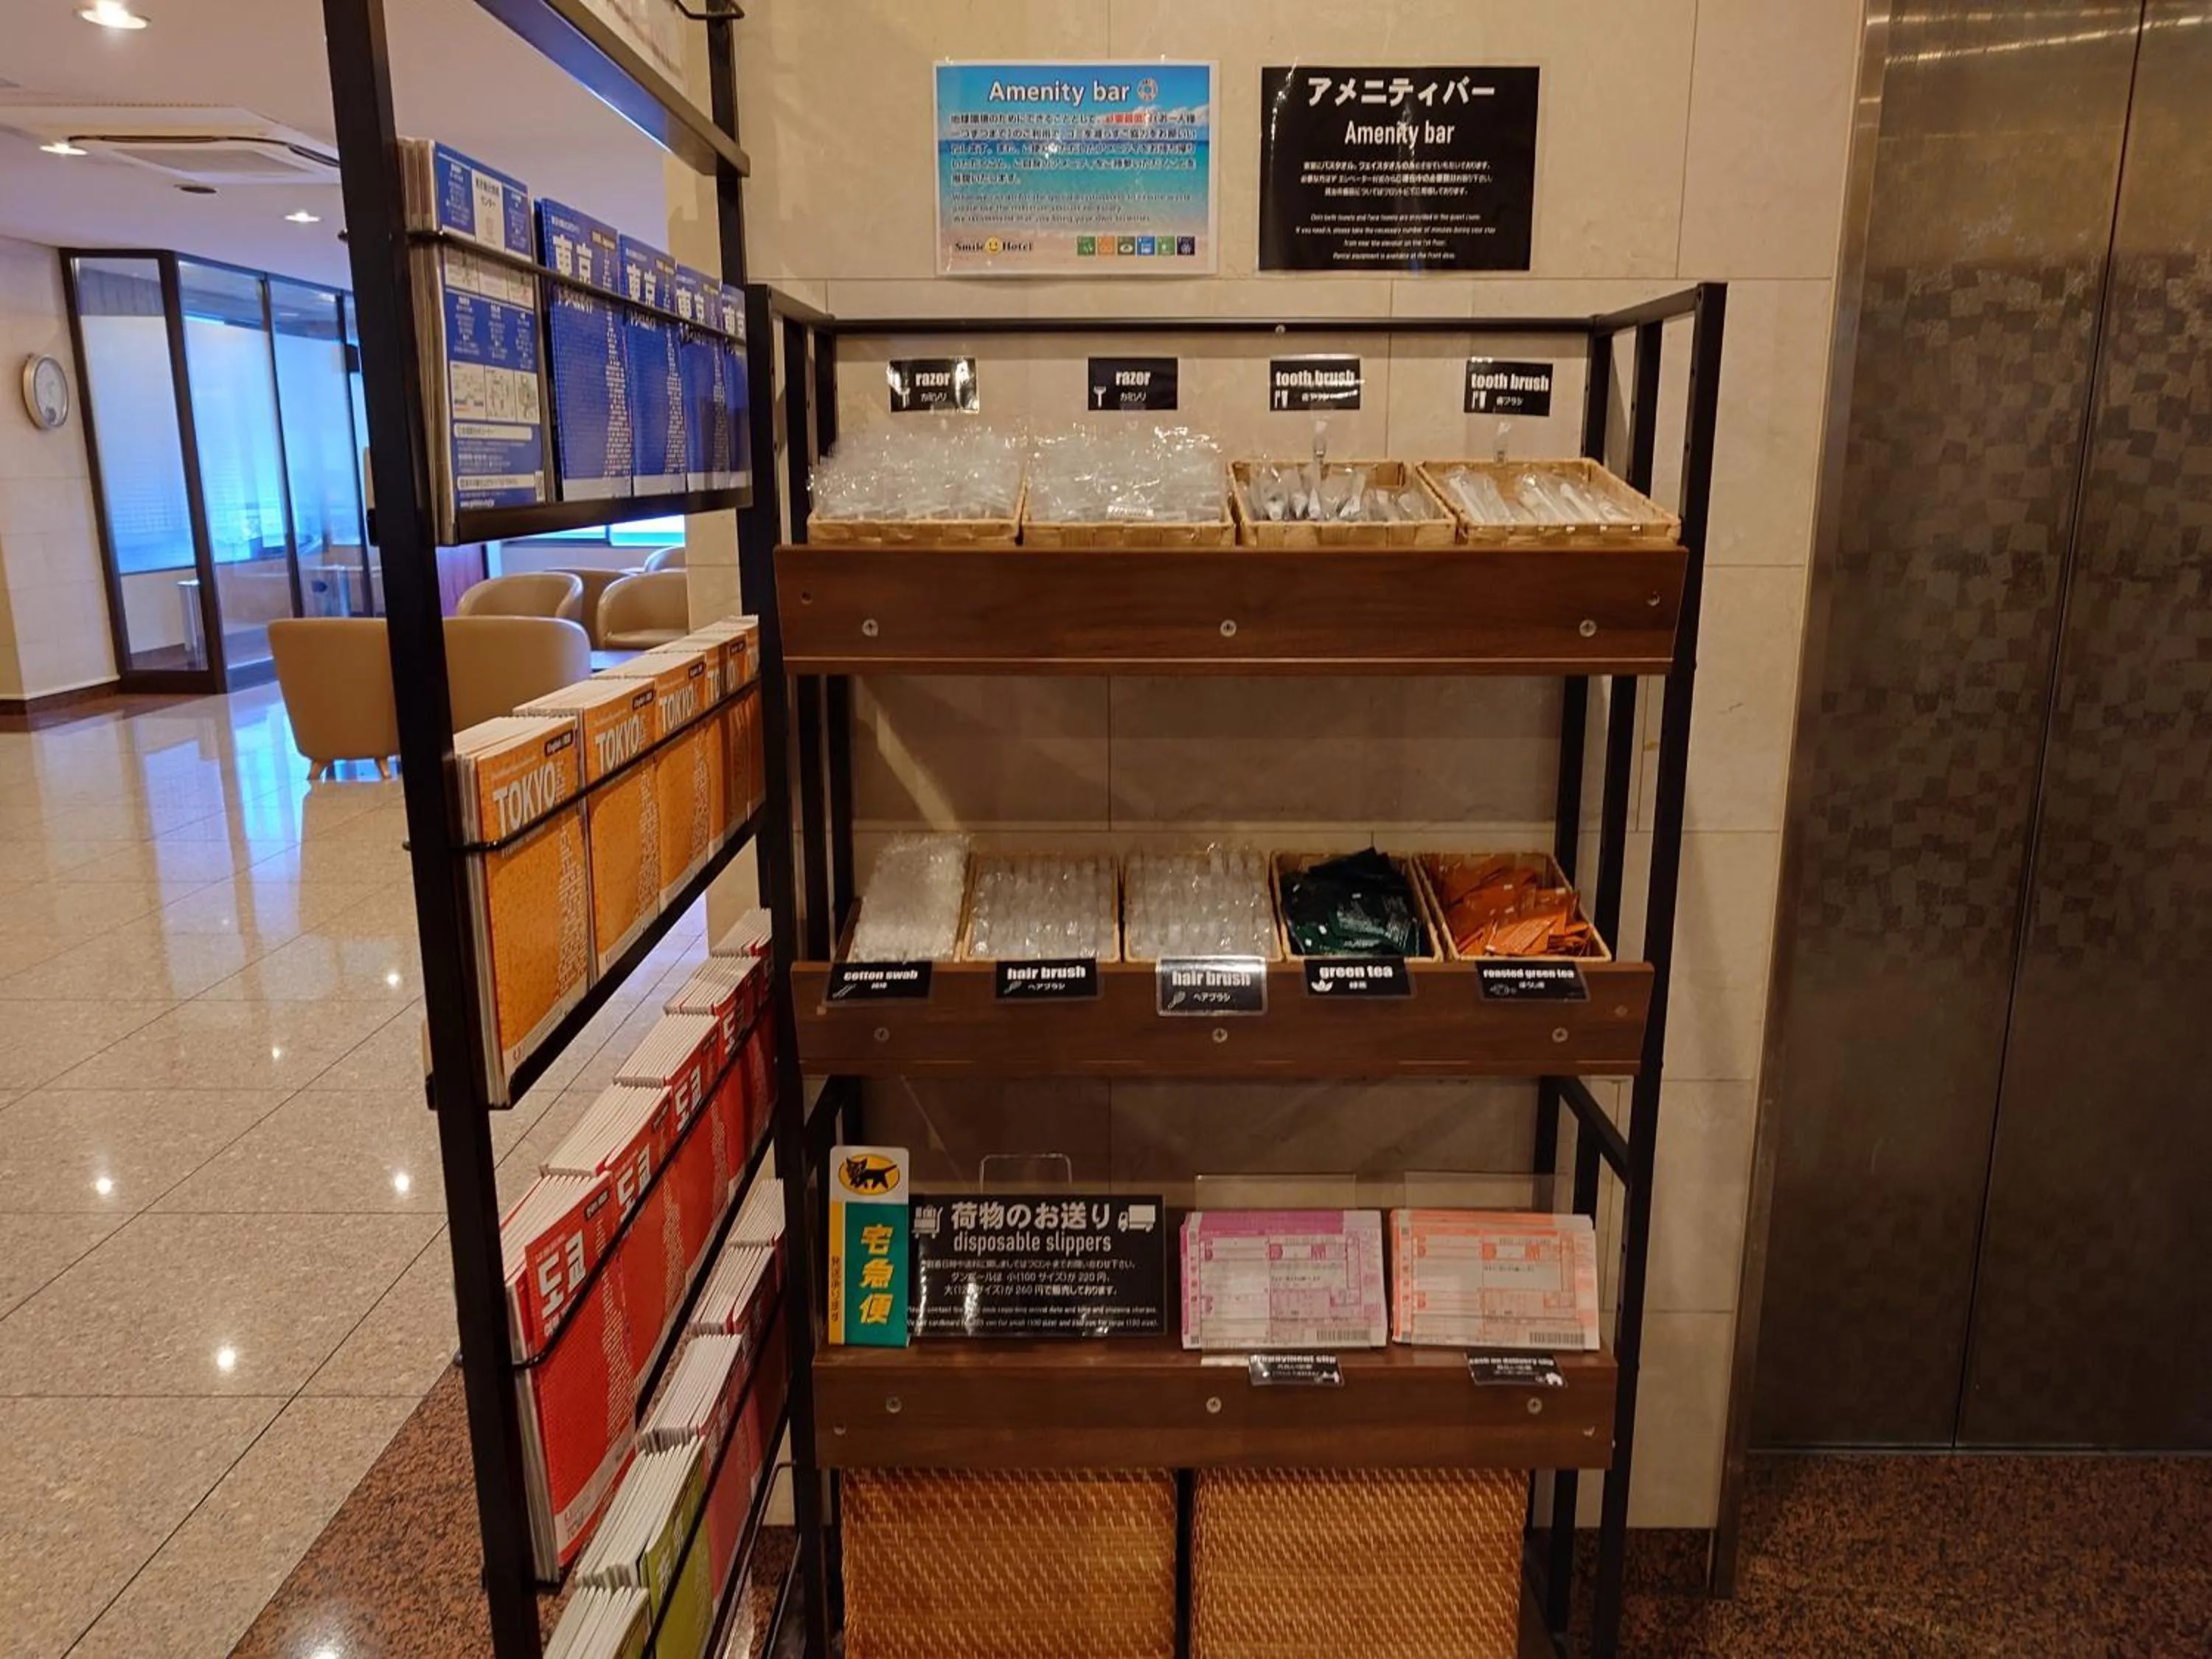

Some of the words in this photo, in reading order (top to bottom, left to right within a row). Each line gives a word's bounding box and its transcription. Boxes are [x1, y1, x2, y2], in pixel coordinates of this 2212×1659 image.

[989, 80, 1084, 107] Amenity
[1093, 80, 1130, 102] bar
[1307, 76, 1495, 106] アメニティバー
[1344, 120, 1419, 149] Amenity
[1425, 120, 1455, 145] bar
[955, 241, 983, 251] Smile
[1002, 241, 1032, 251] Hotel
[915, 371, 950, 387] razor
[1116, 370, 1151, 386] razor
[1275, 369, 1312, 387] tooth
[1315, 369, 1355, 388] brush
[1471, 372, 1508, 390] tooth
[1510, 373, 1549, 391] brush
[659, 682, 695, 734] TOKYO
[595, 714, 640, 777] TOKYO
[493, 762, 555, 838] TOKYO
[843, 970, 884, 981] cotton
[886, 969, 919, 981] swab
[1006, 967, 1040, 980] hair
[1040, 965, 1086, 979] brush
[1172, 970, 1203, 987] hair
[1206, 970, 1251, 987] brush
[1318, 965, 1365, 980] green
[1366, 964, 1394, 978] tea
[950, 1201, 1110, 1231] 荷物のお送り
[953, 1231, 1040, 1256] disposable
[1046, 1231, 1112, 1257] slippers
[538, 1229, 587, 1320] 도쿄
[859, 1223, 894, 1324] 宅急便
